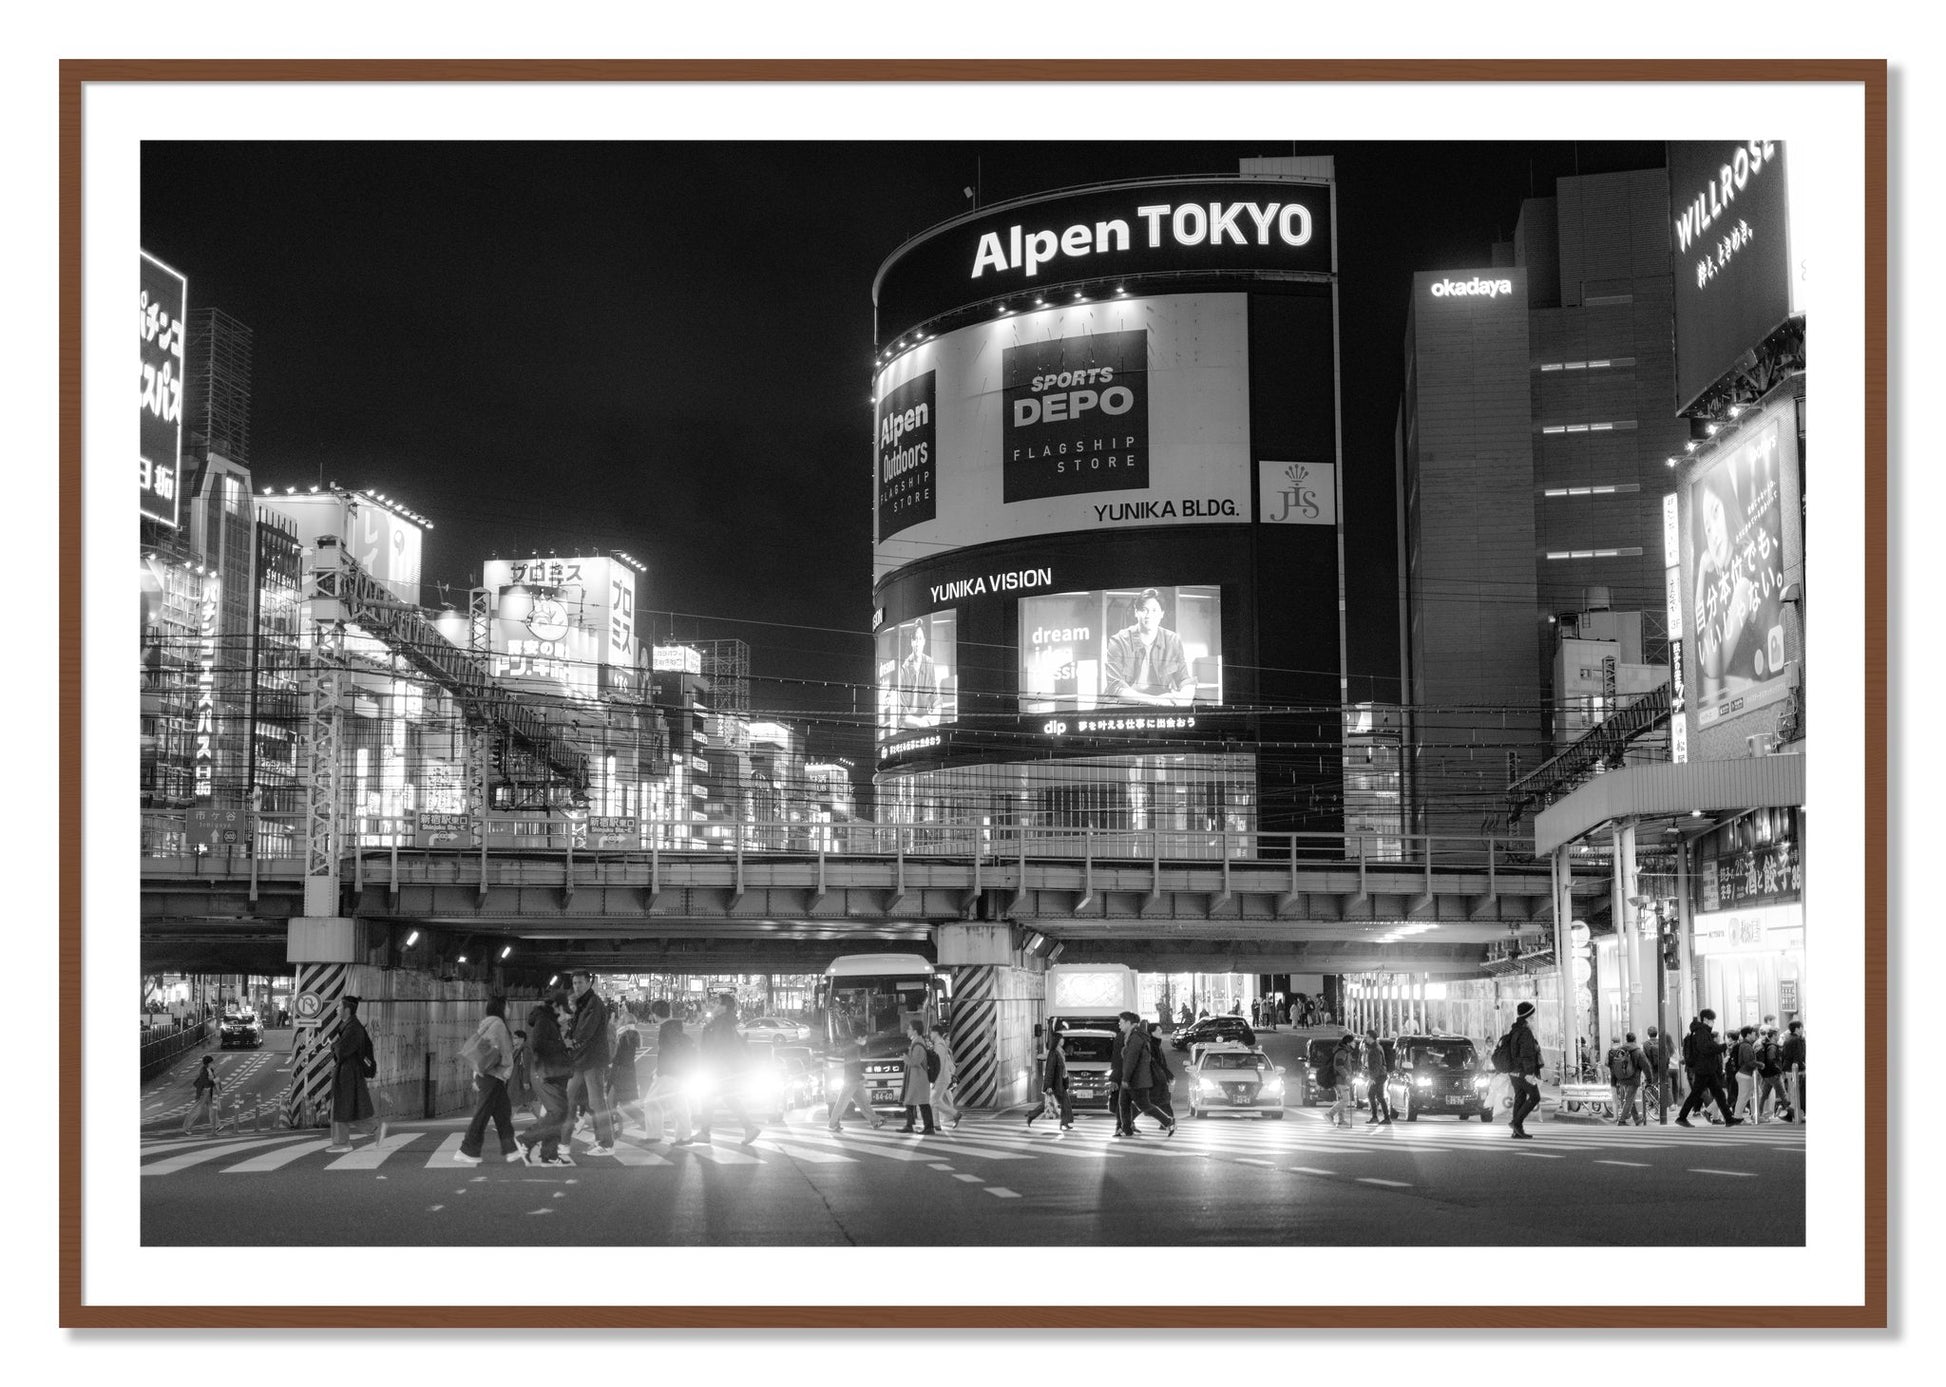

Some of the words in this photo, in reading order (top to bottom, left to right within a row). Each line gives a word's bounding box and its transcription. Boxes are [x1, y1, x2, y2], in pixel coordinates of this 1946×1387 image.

[971, 217, 1130, 278] Alpen
[1138, 202, 1312, 247] TOKYO
[1431, 277, 1512, 299] okadaya
[1031, 366, 1113, 392] SPORTS
[1014, 386, 1134, 428] DEPO
[881, 402, 929, 450] Alpen
[1013, 436, 1135, 461] FLAGSHIP
[883, 442, 928, 483] Outdoors
[1057, 455, 1135, 472] STORE
[880, 471, 929, 505] FLAGSHIP
[894, 488, 929, 512] STORE
[1094, 499, 1176, 522] YUNIKA
[1183, 499, 1240, 517] BLDG.
[265, 569, 297, 591] SHISHA
[510, 561, 583, 585] プロミス
[930, 577, 986, 603] YUNIKA
[989, 568, 1051, 593] VISION
[1032, 626, 1090, 644] dream
[1044, 720, 1067, 736] dip
